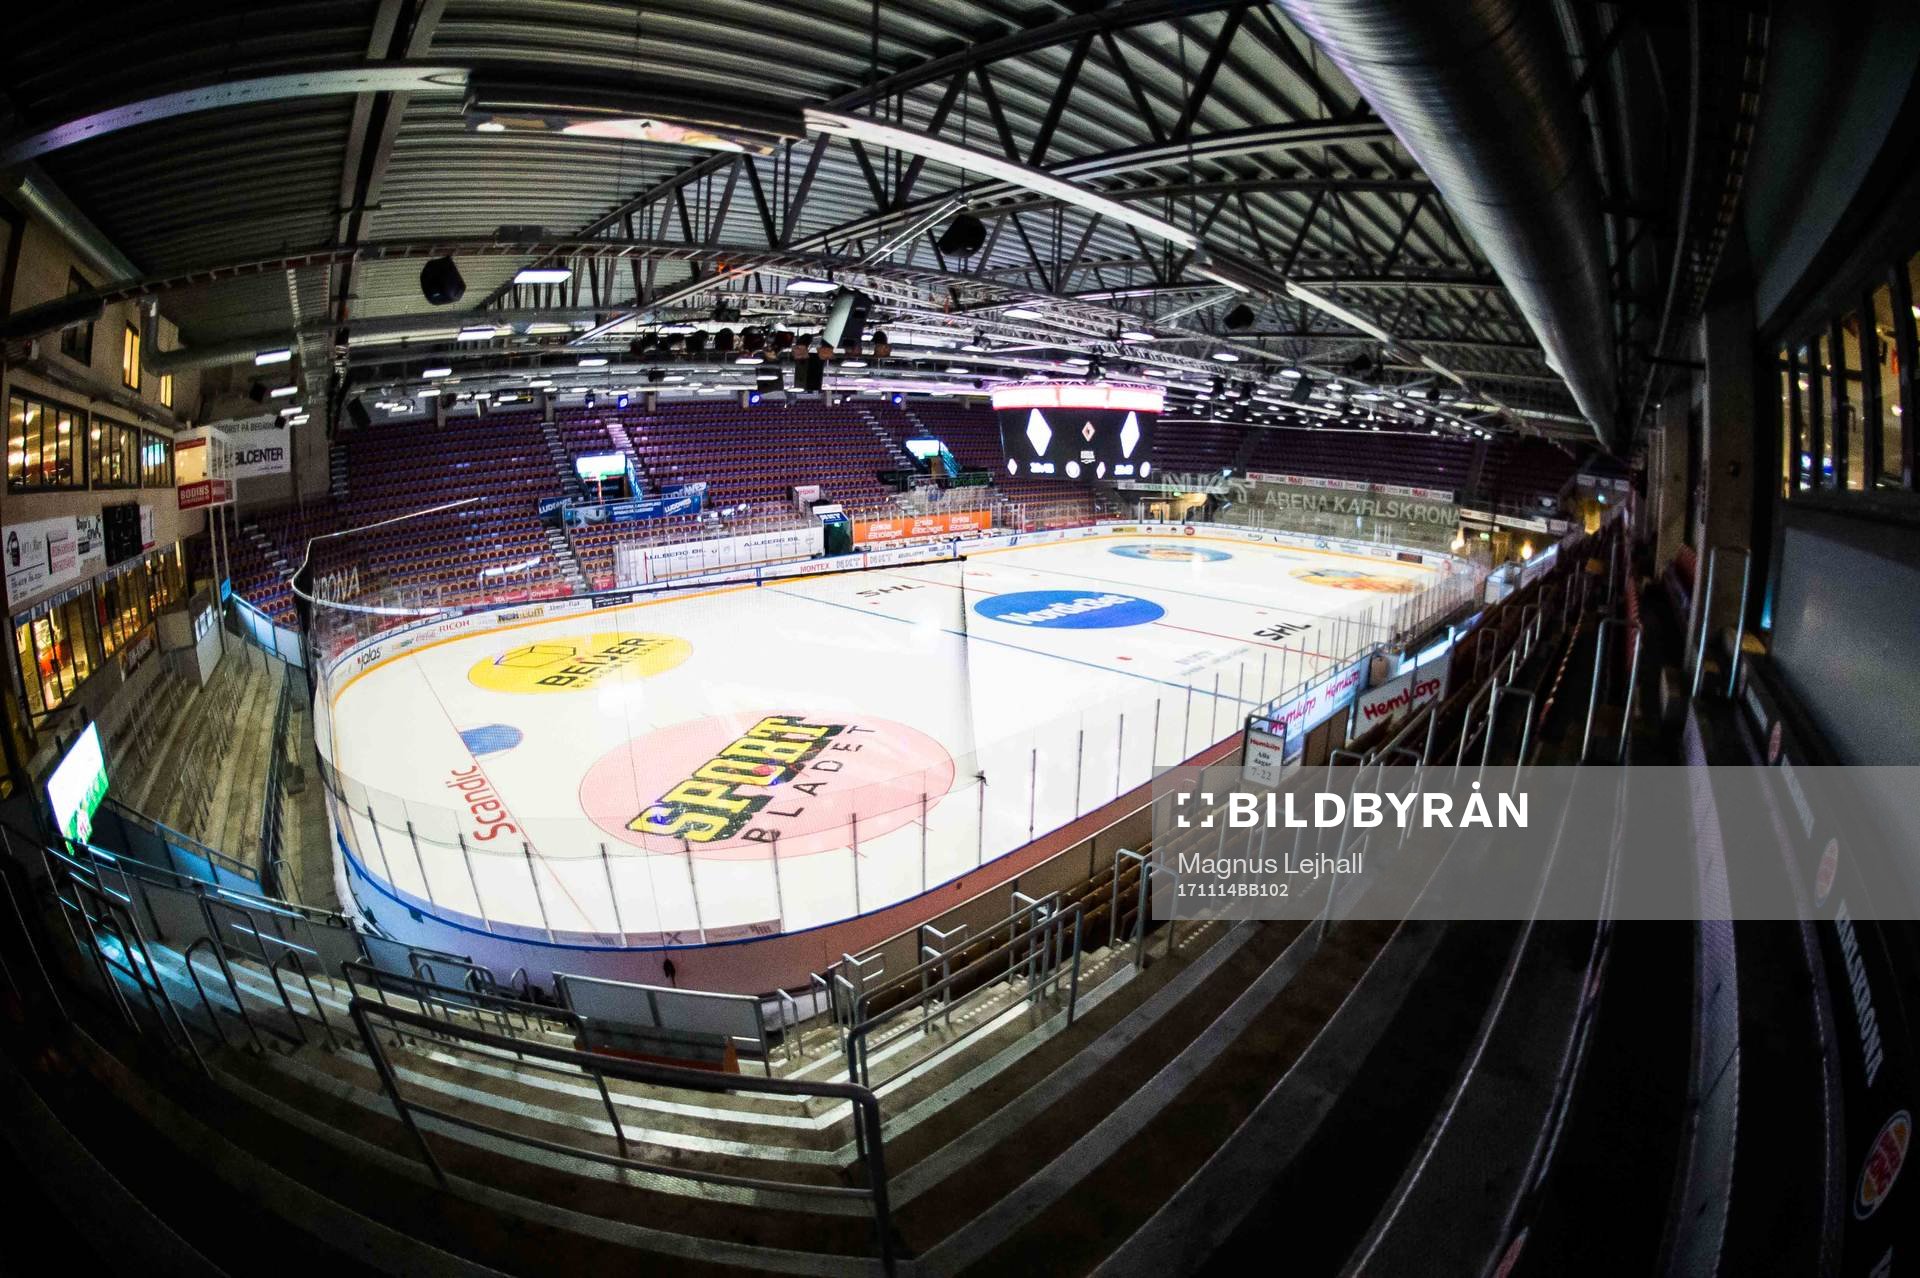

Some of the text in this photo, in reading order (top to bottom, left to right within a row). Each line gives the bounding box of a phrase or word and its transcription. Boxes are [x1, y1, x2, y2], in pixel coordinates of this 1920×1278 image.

[1265, 490, 1328, 511] ARENA
[1333, 496, 1460, 526] KARLSKRONA
[800, 562, 830, 574] MONTEX
[856, 585, 925, 597] SHL
[439, 619, 470, 633] RICOH
[1253, 623, 1312, 641] SHL
[625, 715, 847, 842] SPORT
[1251, 767, 1271, 781] 7-22
[741, 725, 875, 842] BLADET
[445, 765, 517, 841] Scandic
